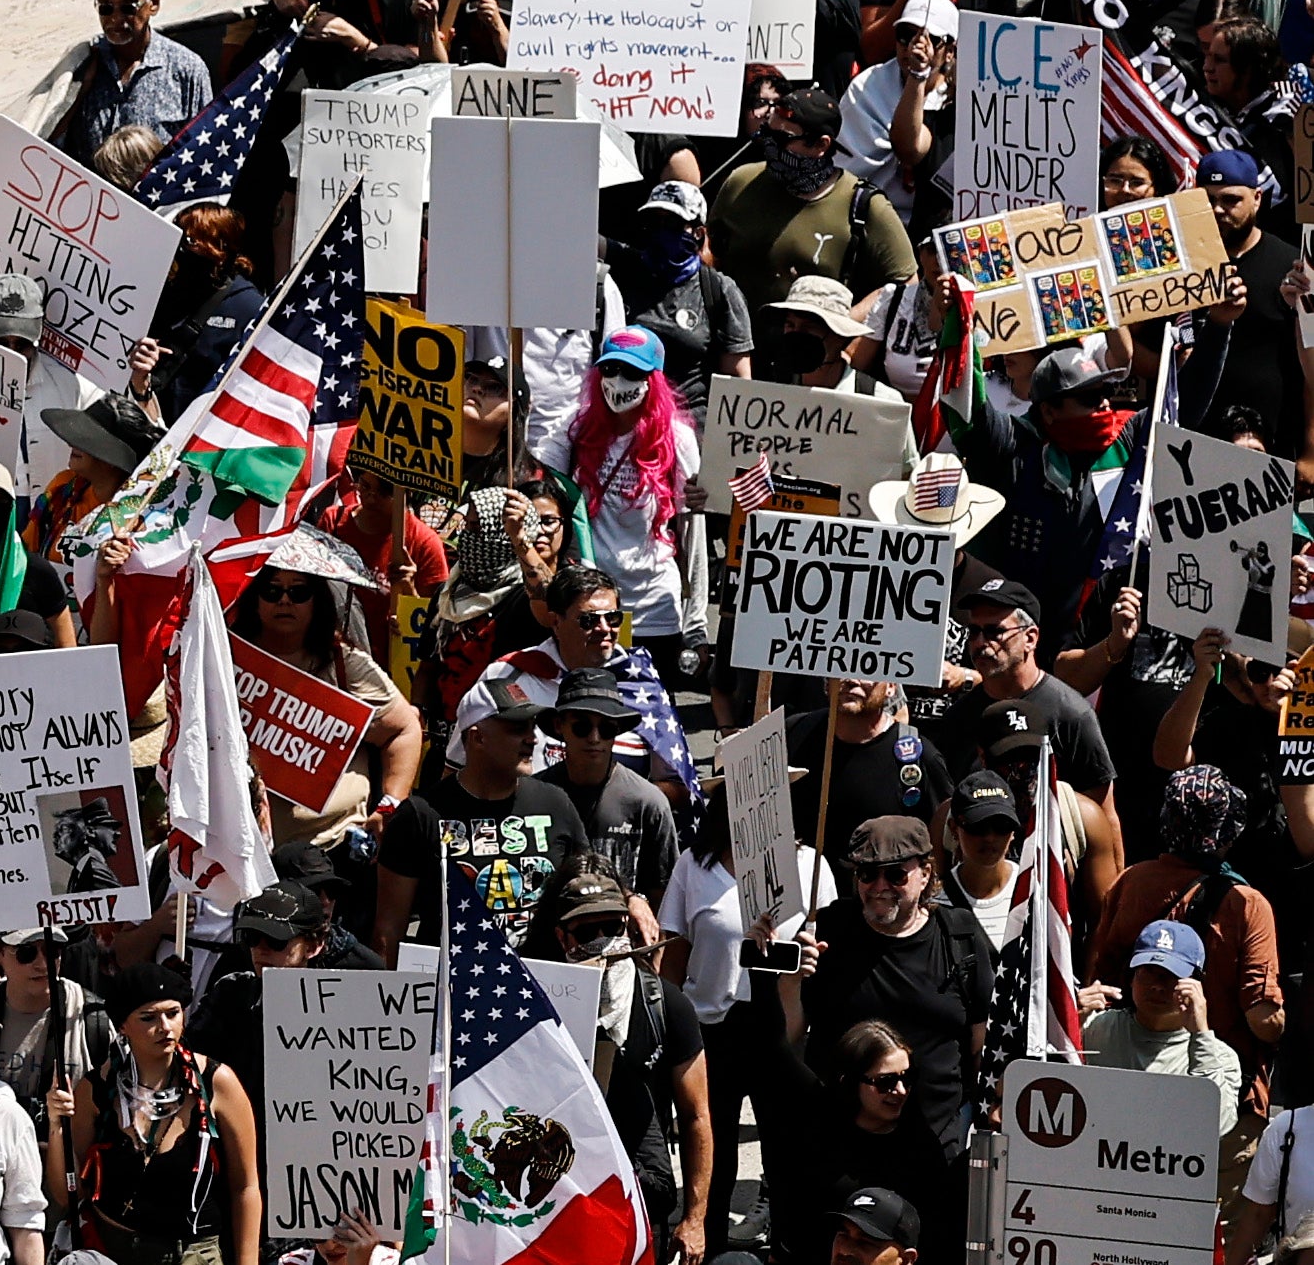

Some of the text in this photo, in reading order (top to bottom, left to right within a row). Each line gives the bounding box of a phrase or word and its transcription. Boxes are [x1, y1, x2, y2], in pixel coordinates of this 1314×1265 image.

[314, 98, 419, 125] TRUMP
[458, 76, 561, 116] ANNE
[649, 89, 715, 121] NOW!
[971, 90, 1075, 157] MELTS
[975, 144, 1066, 202] UNDER
[8, 143, 120, 245] STOP
[8, 207, 135, 314] HITTING
[717, 394, 859, 435] NORMAL
[380, 438, 455, 481] IRAN!
[730, 431, 812, 456] PEOPLE
[749, 515, 948, 565] WE ARE NOT
[741, 551, 947, 623] RIOTING
[784, 618, 883, 645] WE ARE
[769, 639, 914, 678] PATRIOTS
[43, 710, 123, 750] ALWAYS
[268, 689, 354, 751] TRUMP!
[249, 724, 323, 773] MUSK!
[21, 755, 101, 790] Itself
[37, 896, 117, 927] RESIST!
[300, 978, 340, 1014] IF
[277, 1025, 416, 1052] WANTED
[329, 1059, 421, 1095] KING,
[273, 1100, 423, 1124] WE WOULD
[333, 1132, 415, 1158] PICKED
[1097, 1139, 1205, 1176] Metro
[277, 1164, 381, 1230] JASON
[1012, 1190, 1157, 1224] 4 Santa Monica
